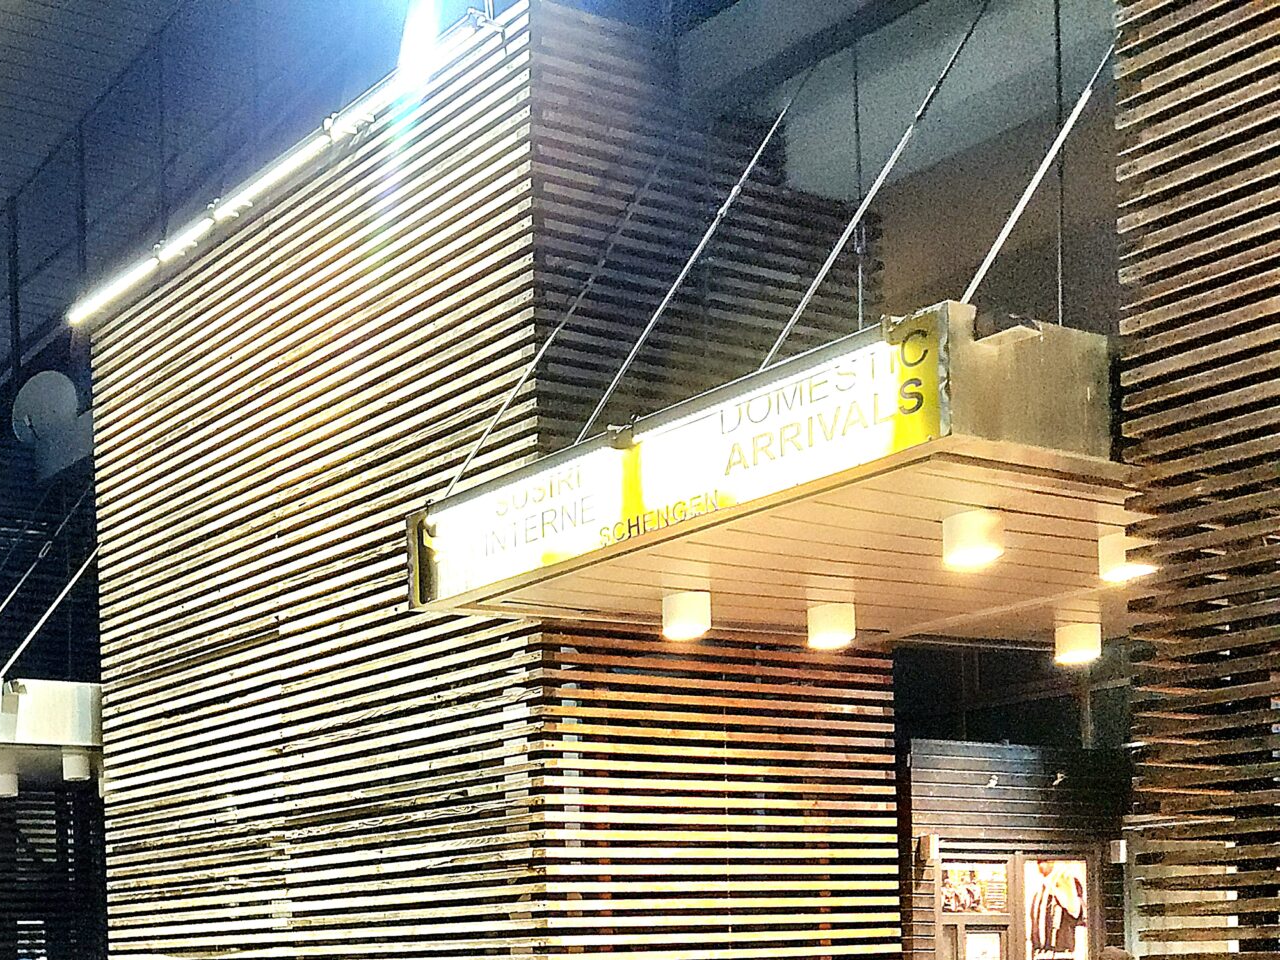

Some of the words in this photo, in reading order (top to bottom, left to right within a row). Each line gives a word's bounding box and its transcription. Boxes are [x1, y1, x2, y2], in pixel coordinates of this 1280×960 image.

[720, 329, 929, 435] DOMESTIC
[724, 377, 925, 476] ARRIVALS
[484, 493, 597, 558] INTERNE
[599, 488, 720, 547] SCHENGEN
